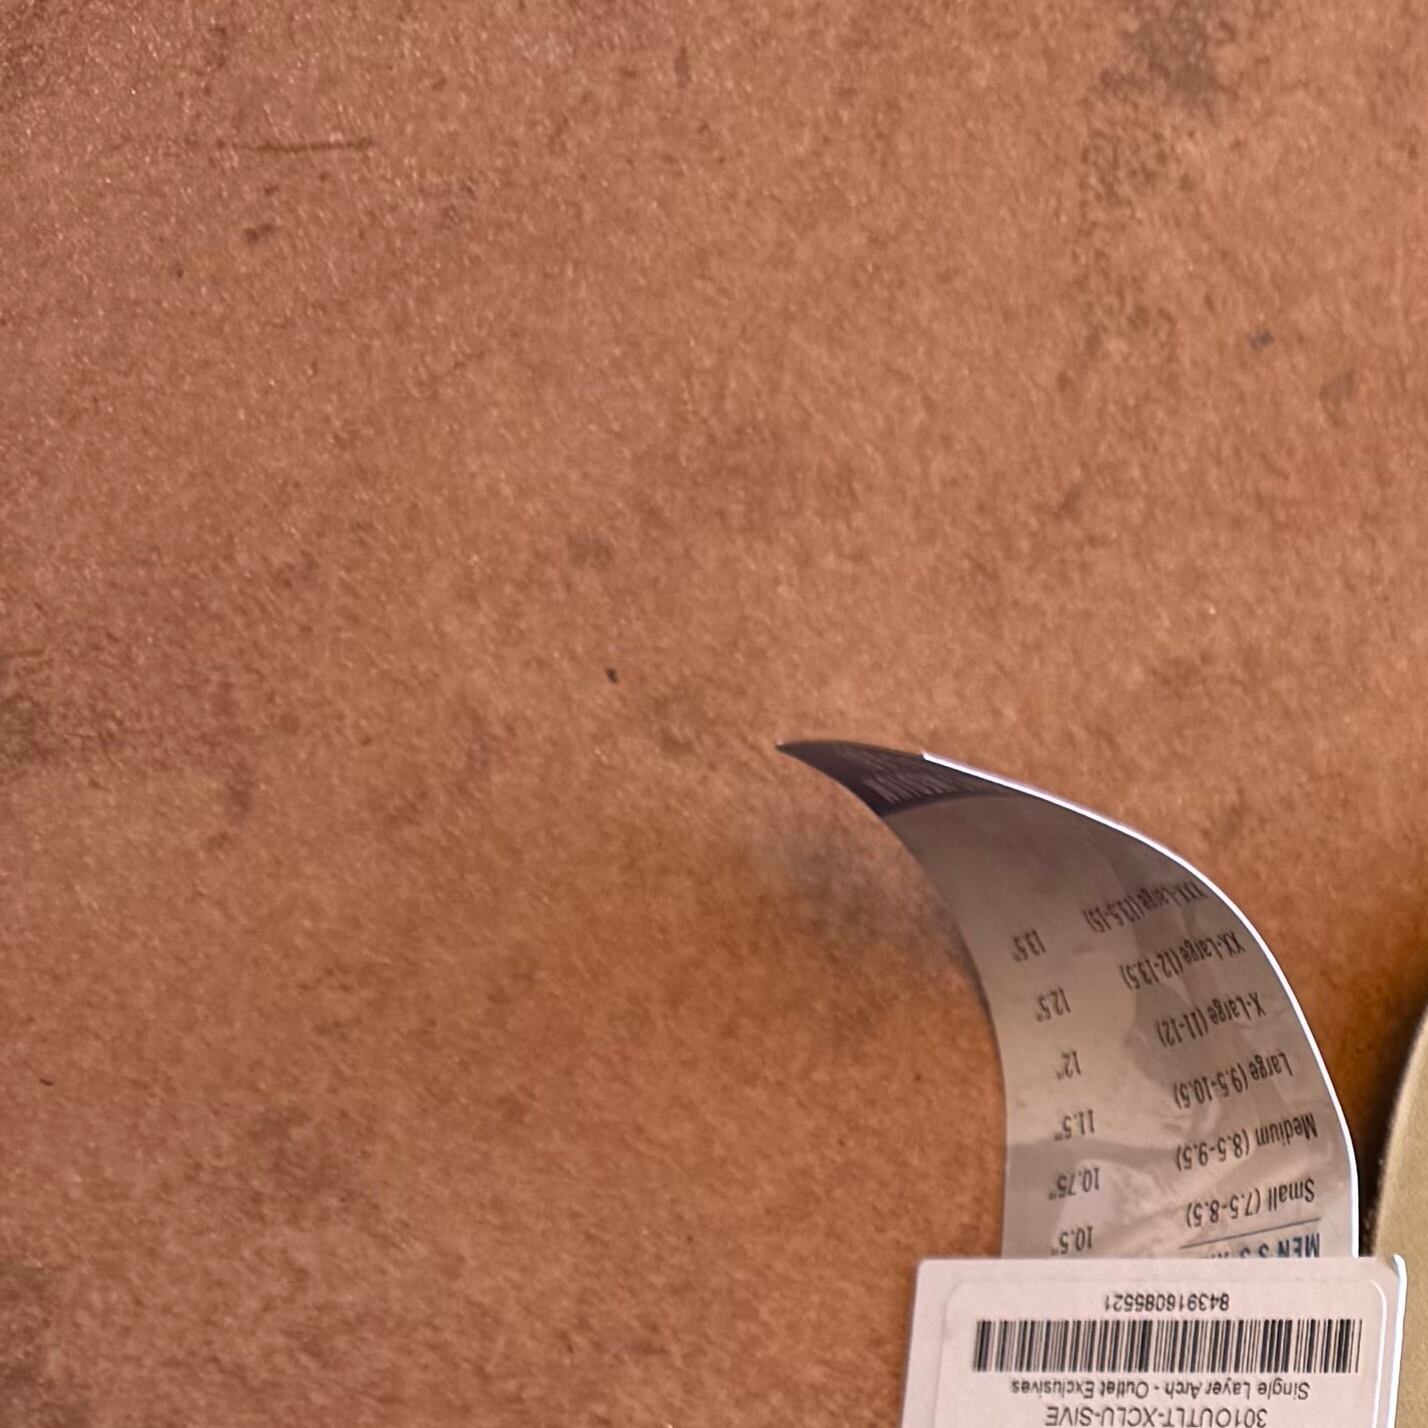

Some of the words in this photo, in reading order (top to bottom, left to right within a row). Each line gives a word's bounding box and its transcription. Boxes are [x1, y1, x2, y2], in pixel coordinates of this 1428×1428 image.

[1182, 931, 1246, 965] XX-Large
[1120, 952, 1184, 990] (12-13.5)
[1036, 987, 1071, 1022] 12.5"
[1208, 992, 1266, 1026] X-Large
[1156, 1005, 1210, 1047] (11-12)
[1057, 1050, 1082, 1080] 12"
[1250, 1052, 1294, 1081] Large
[1175, 1063, 1248, 1109] (9.5-10.5)
[1053, 1108, 1095, 1141] 11.5"
[1256, 1112, 1319, 1147] Medium
[1176, 1128, 1250, 1171] (8.5-9.5)
[1048, 1167, 1100, 1200] 10.75"
[1268, 1177, 1315, 1211] Small
[1186, 1189, 1261, 1228] (7.5-8.5)
[1050, 1225, 1094, 1256] 10.5"
[1103, 1292, 1231, 1312] 843916085521
[1011, 1379, 1095, 1397] Exclusives
[1099, 1380, 1149, 1397] Outlet
[1164, 1380, 1203, 1398] Arch
[1205, 1378, 1250, 1398] Layer
[1258, 1378, 1311, 1400] Single
